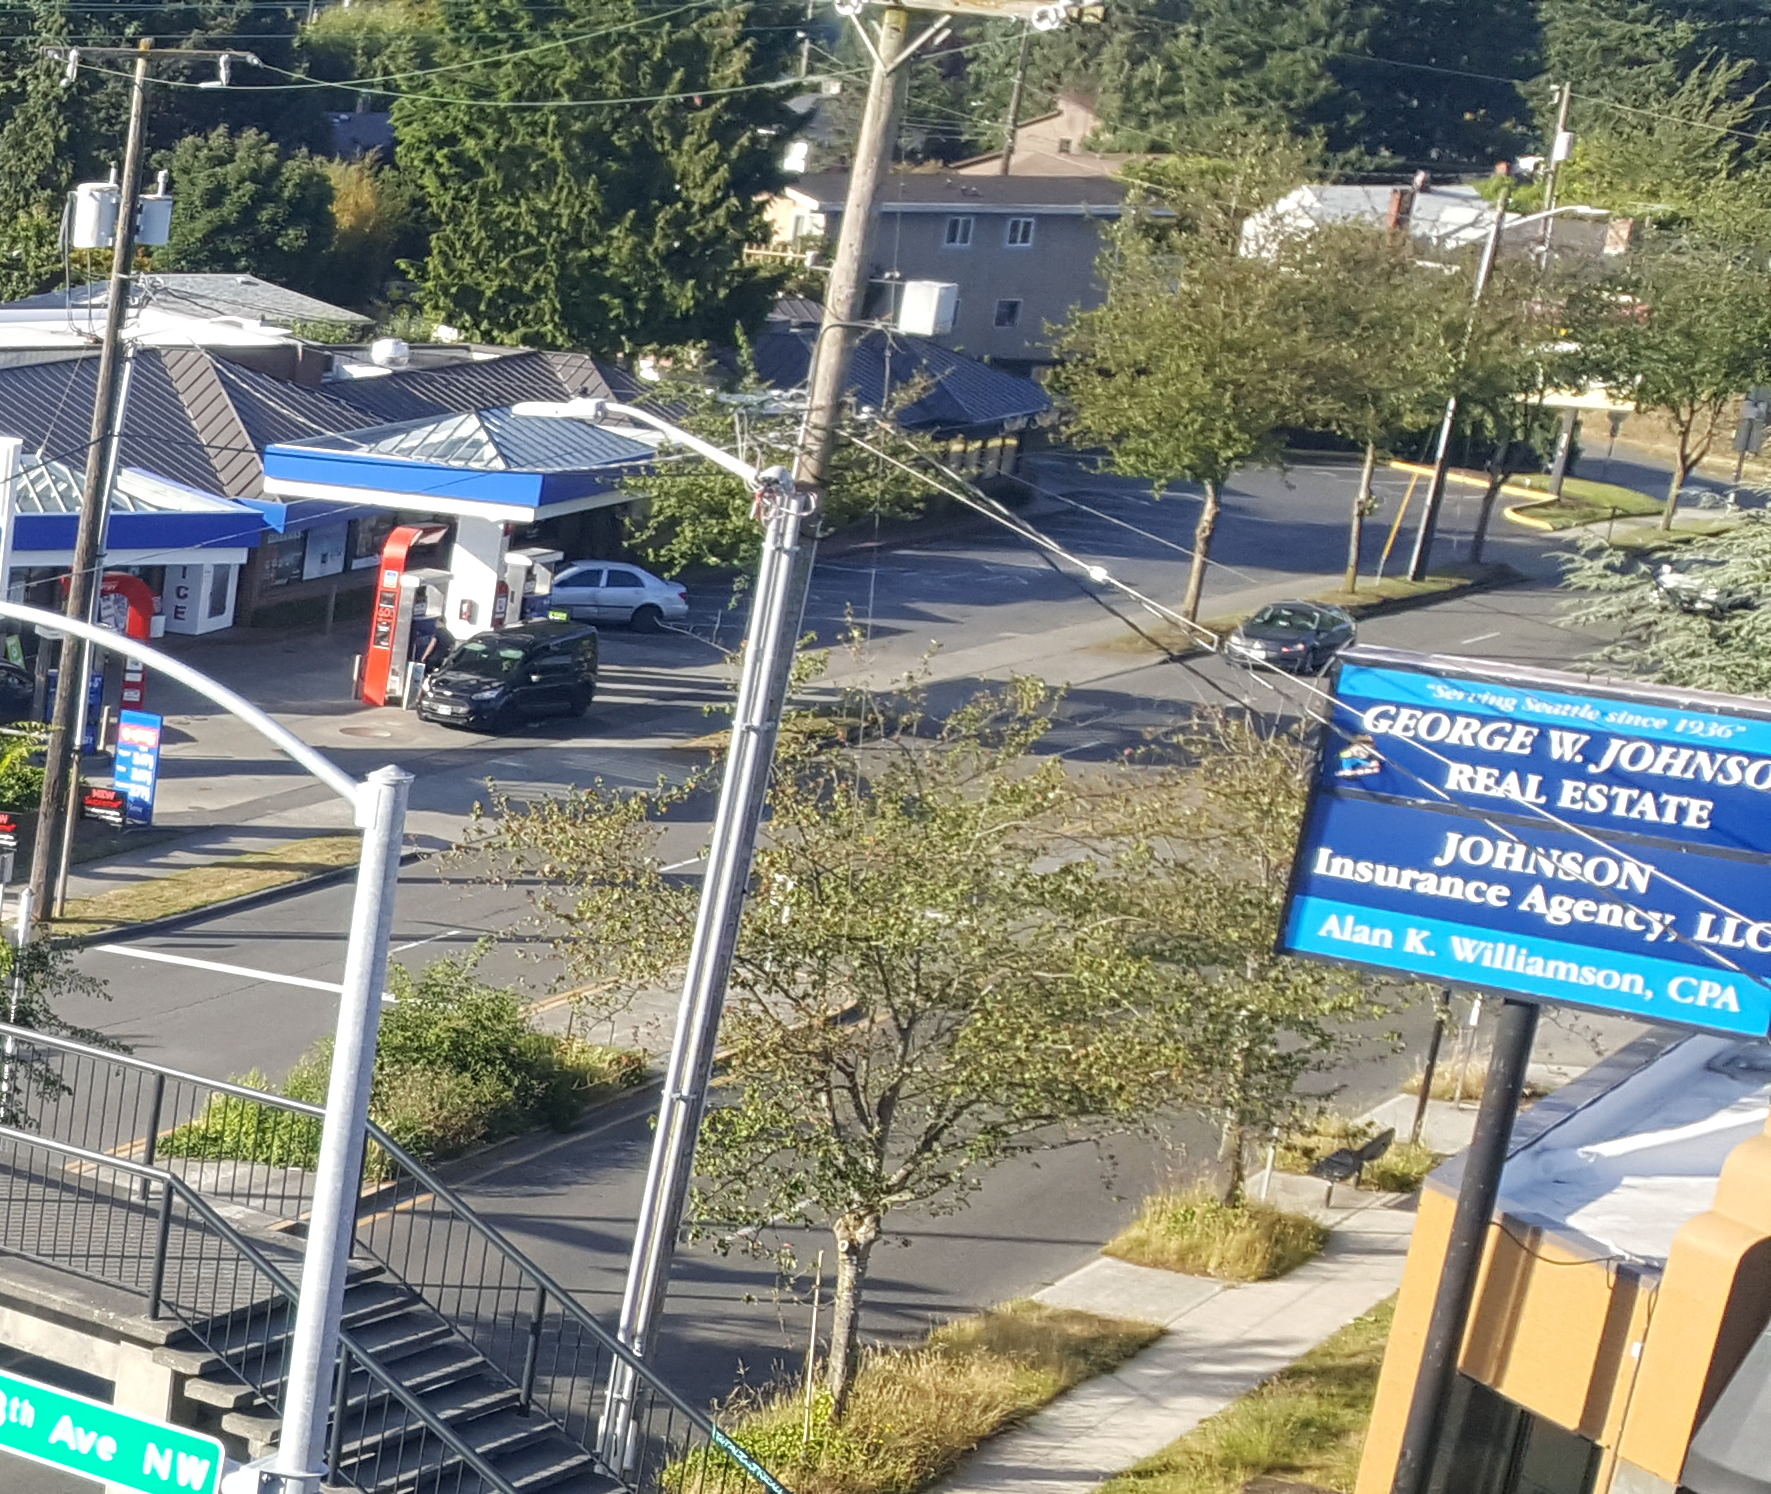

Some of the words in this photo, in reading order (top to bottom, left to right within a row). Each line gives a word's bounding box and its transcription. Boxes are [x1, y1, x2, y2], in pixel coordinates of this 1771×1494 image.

[1363, 705, 1539, 755] GEORGE
[1549, 729, 1591, 763] W.
[1605, 711, 1668, 729] since
[1445, 762, 1547, 804] REAL
[1557, 779, 1714, 829] ESTATE
[1314, 847, 1512, 907] Insurance
[1432, 831, 1656, 894] JOHNSON
[1317, 914, 1393, 949] Alan
[1403, 927, 1437, 957] K.
[1450, 935, 1653, 1000] Williamson,
[1667, 976, 1741, 1012] CPA
[47, 1414, 117, 1461] Ave
[142, 1442, 211, 1491] NW
